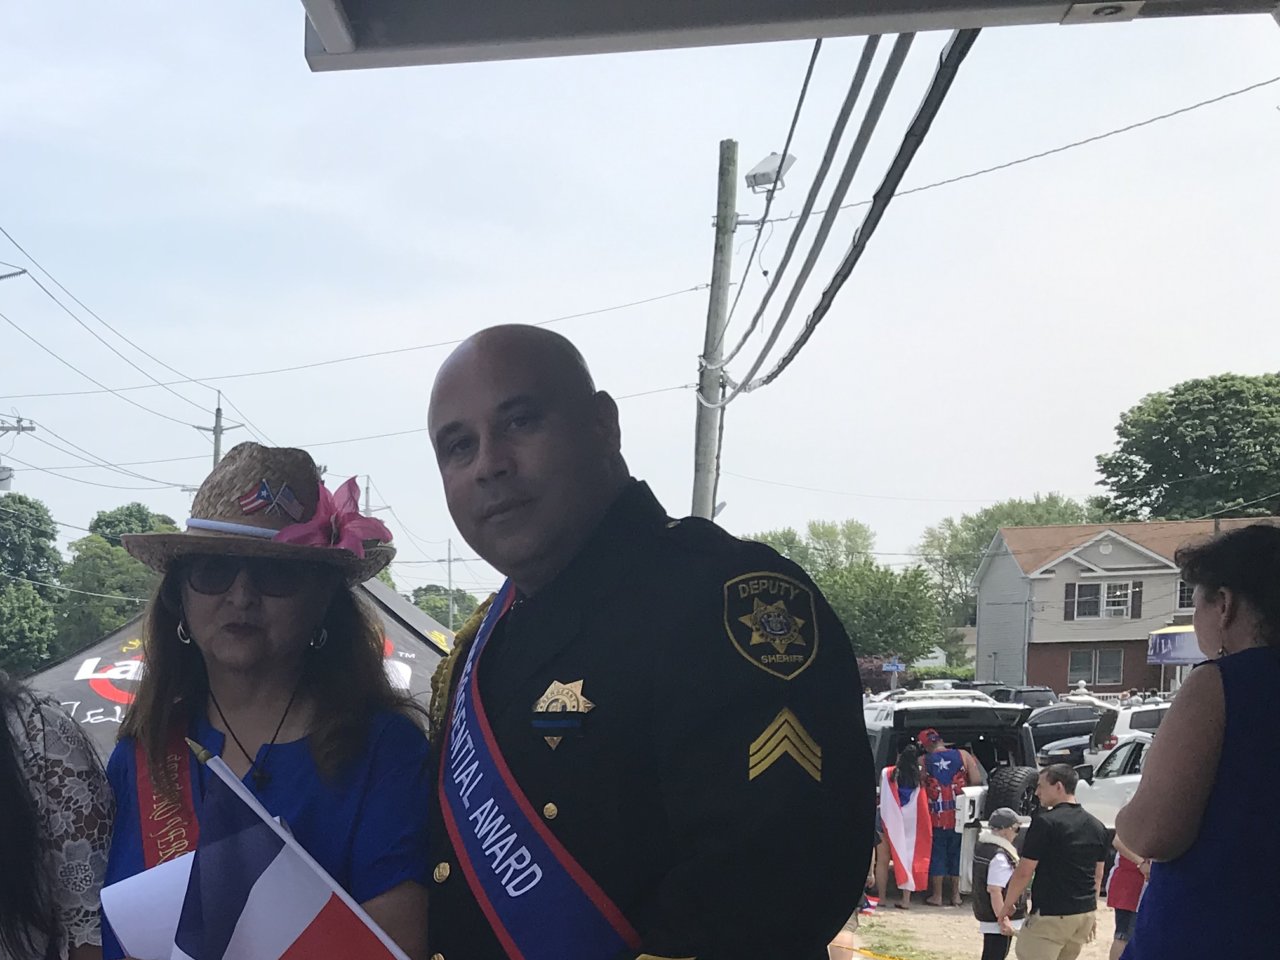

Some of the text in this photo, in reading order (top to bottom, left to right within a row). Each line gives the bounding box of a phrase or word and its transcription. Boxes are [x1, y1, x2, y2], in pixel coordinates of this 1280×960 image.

[738, 580, 800, 600] DEPUTY
[760, 655, 804, 663] SHERIFF
[469, 798, 543, 897] AWARD
